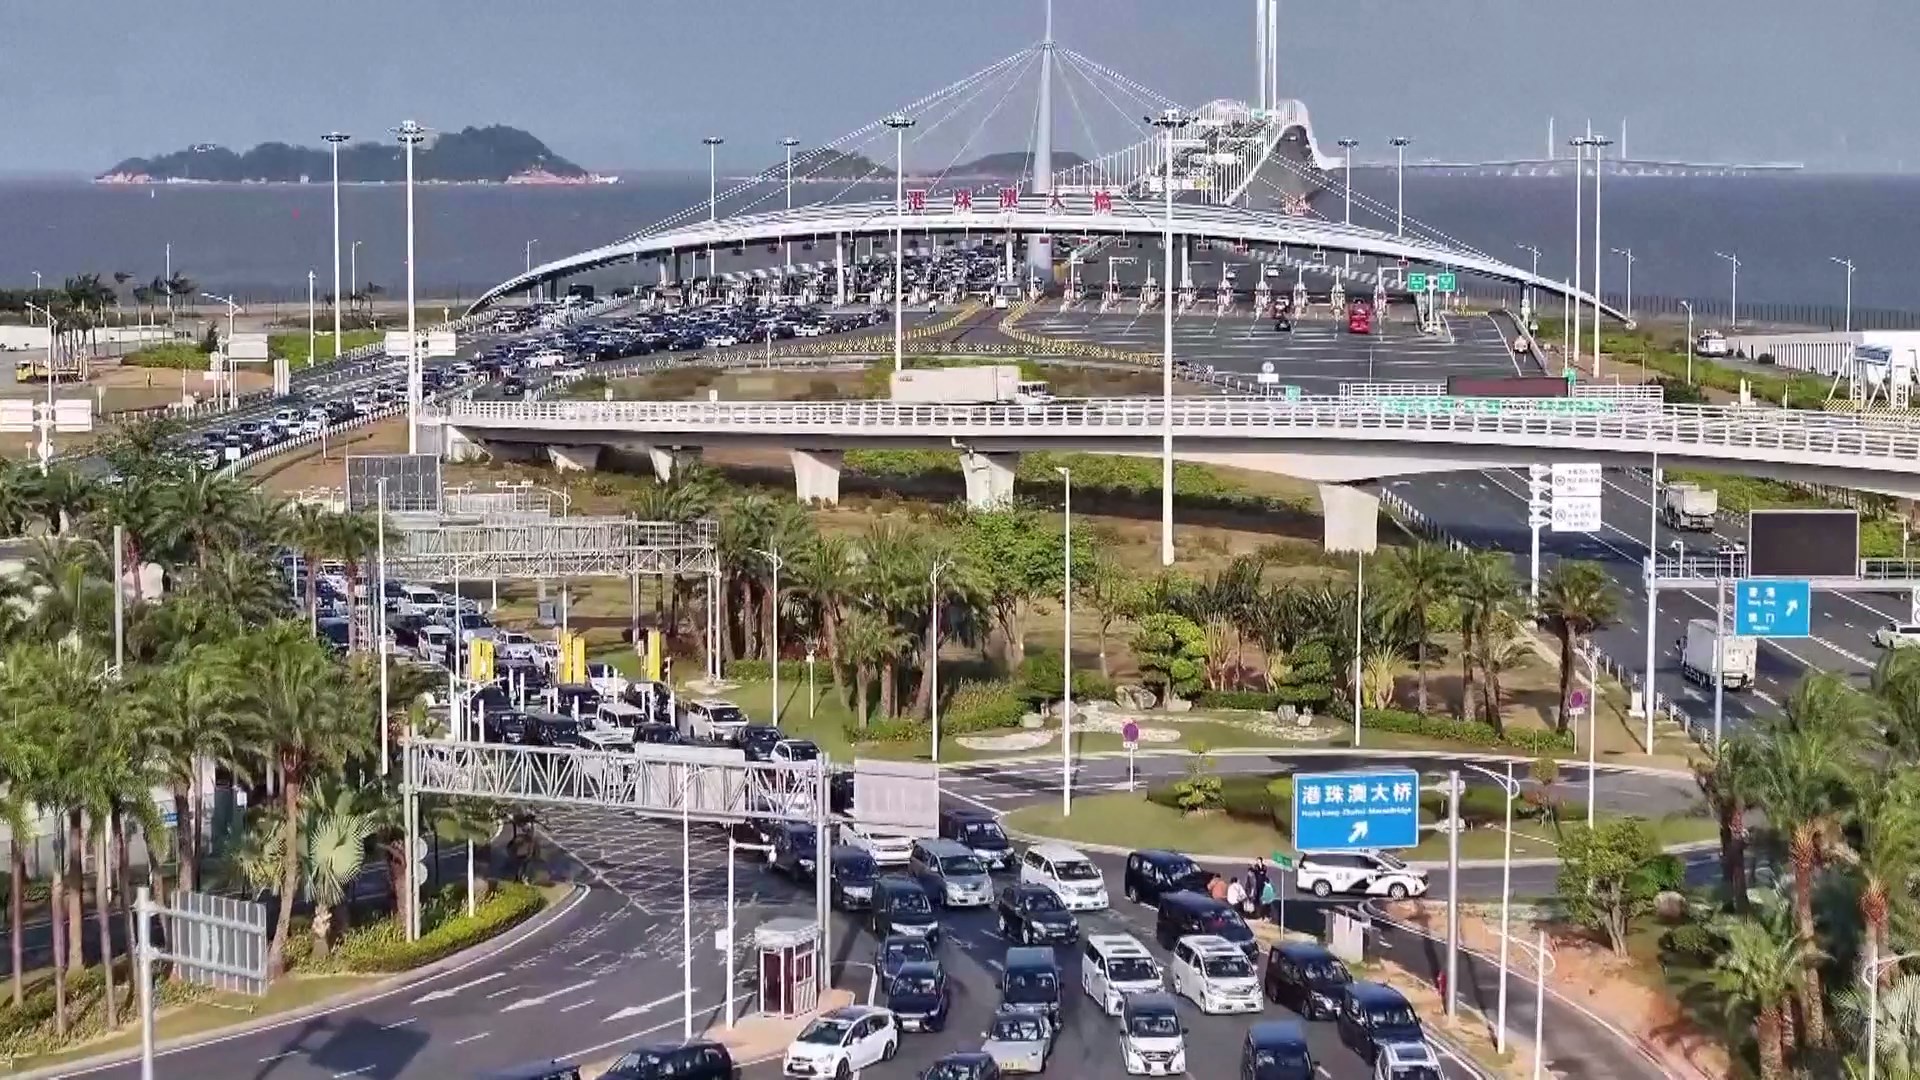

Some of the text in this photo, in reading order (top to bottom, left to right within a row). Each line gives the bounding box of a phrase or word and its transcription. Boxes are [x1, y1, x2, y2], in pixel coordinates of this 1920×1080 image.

[1302, 782, 1412, 805] 港珠澳大桥
